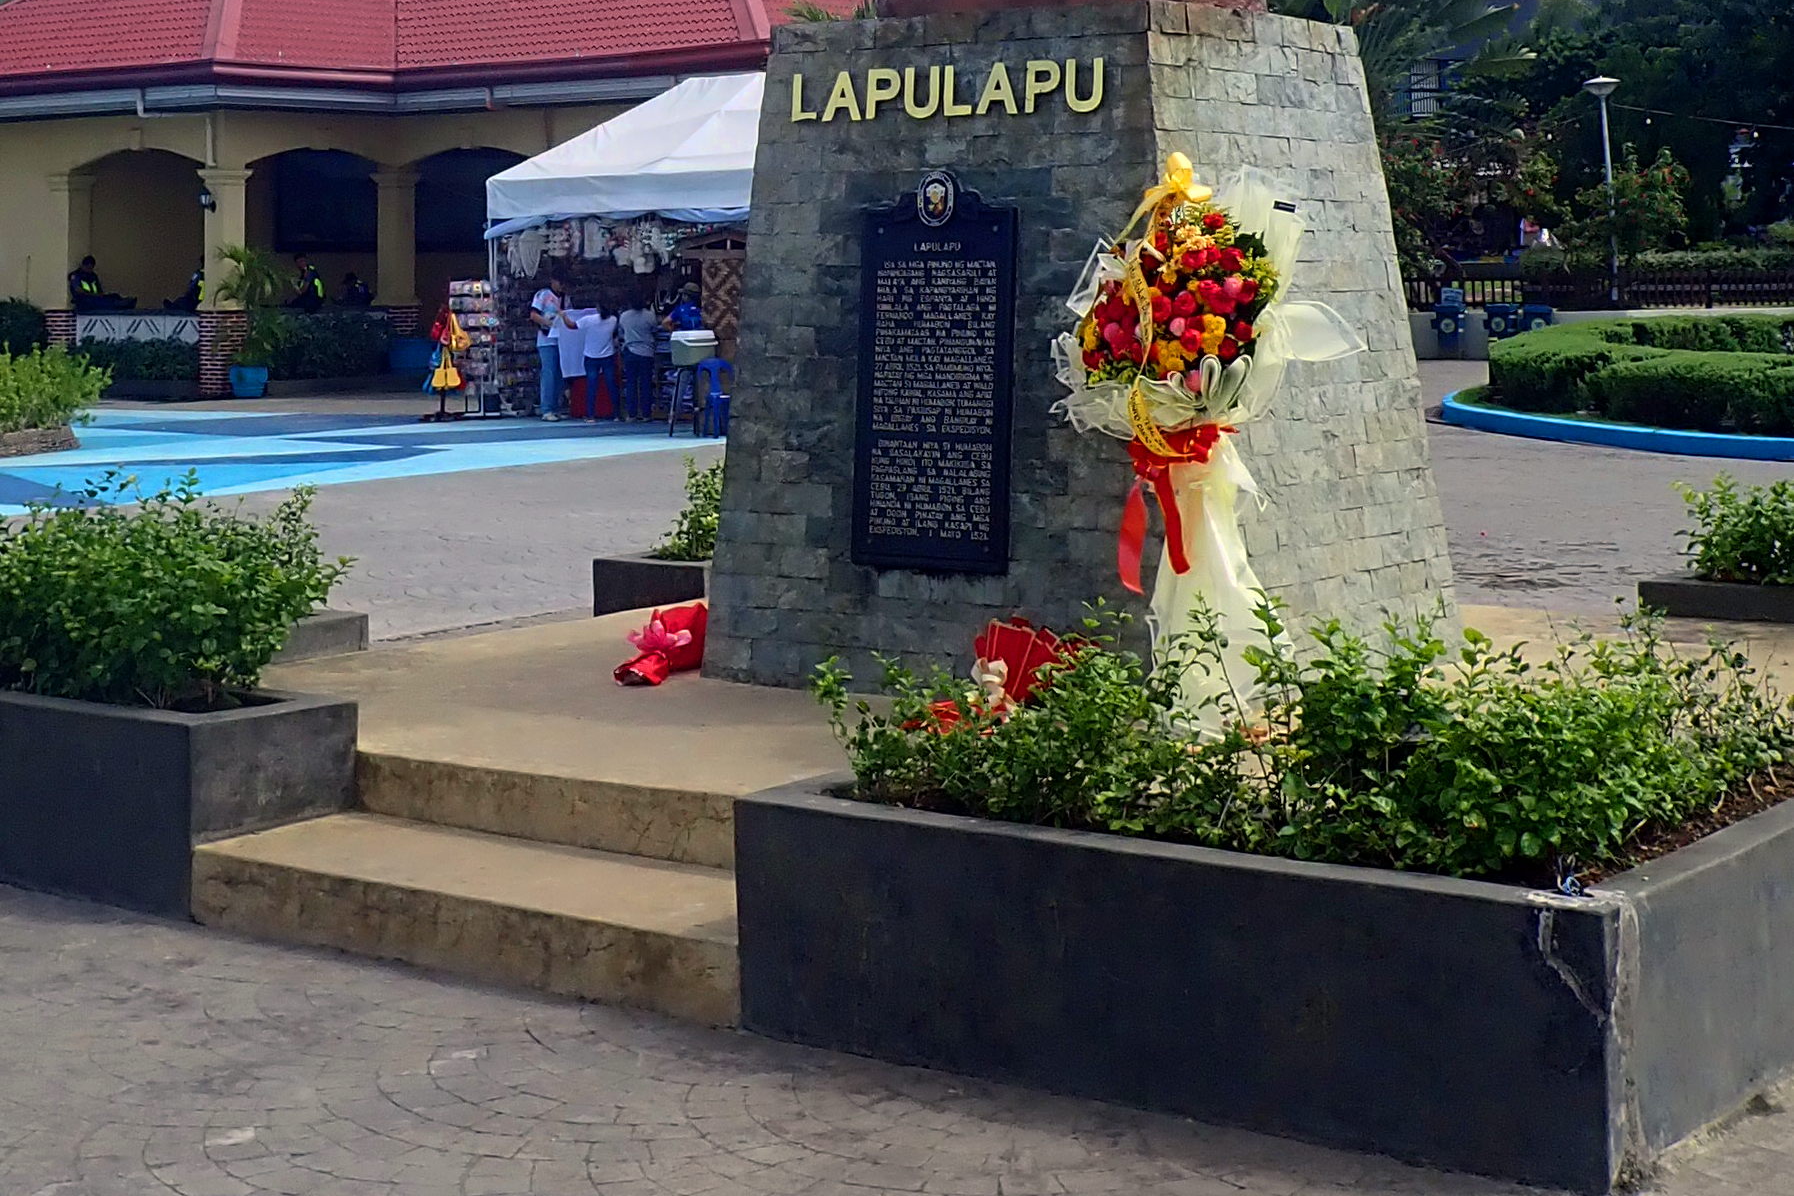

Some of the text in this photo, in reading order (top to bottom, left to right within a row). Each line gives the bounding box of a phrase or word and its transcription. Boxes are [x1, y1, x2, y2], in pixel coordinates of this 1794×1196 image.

[791, 57, 1104, 123] LAPULAPU
[913, 241, 962, 252] LAPULAPU
[910, 277, 925, 285] ANG
